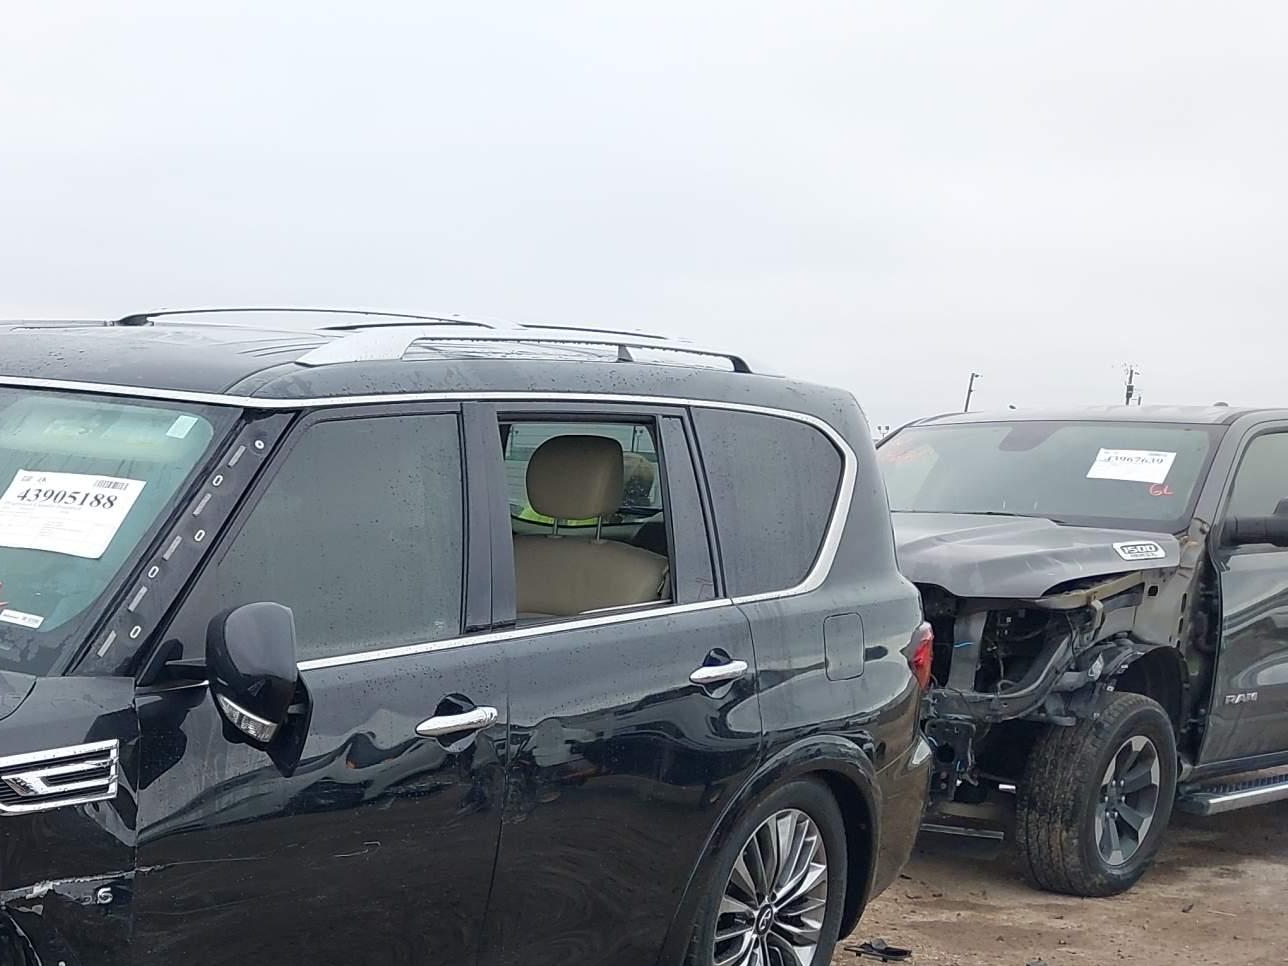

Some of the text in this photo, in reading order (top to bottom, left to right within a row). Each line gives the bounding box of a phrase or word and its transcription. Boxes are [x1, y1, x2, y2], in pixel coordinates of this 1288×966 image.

[16, 487, 118, 510] 43905188
[1122, 545, 1157, 555] 1500
[1225, 691, 1258, 705] RAM
